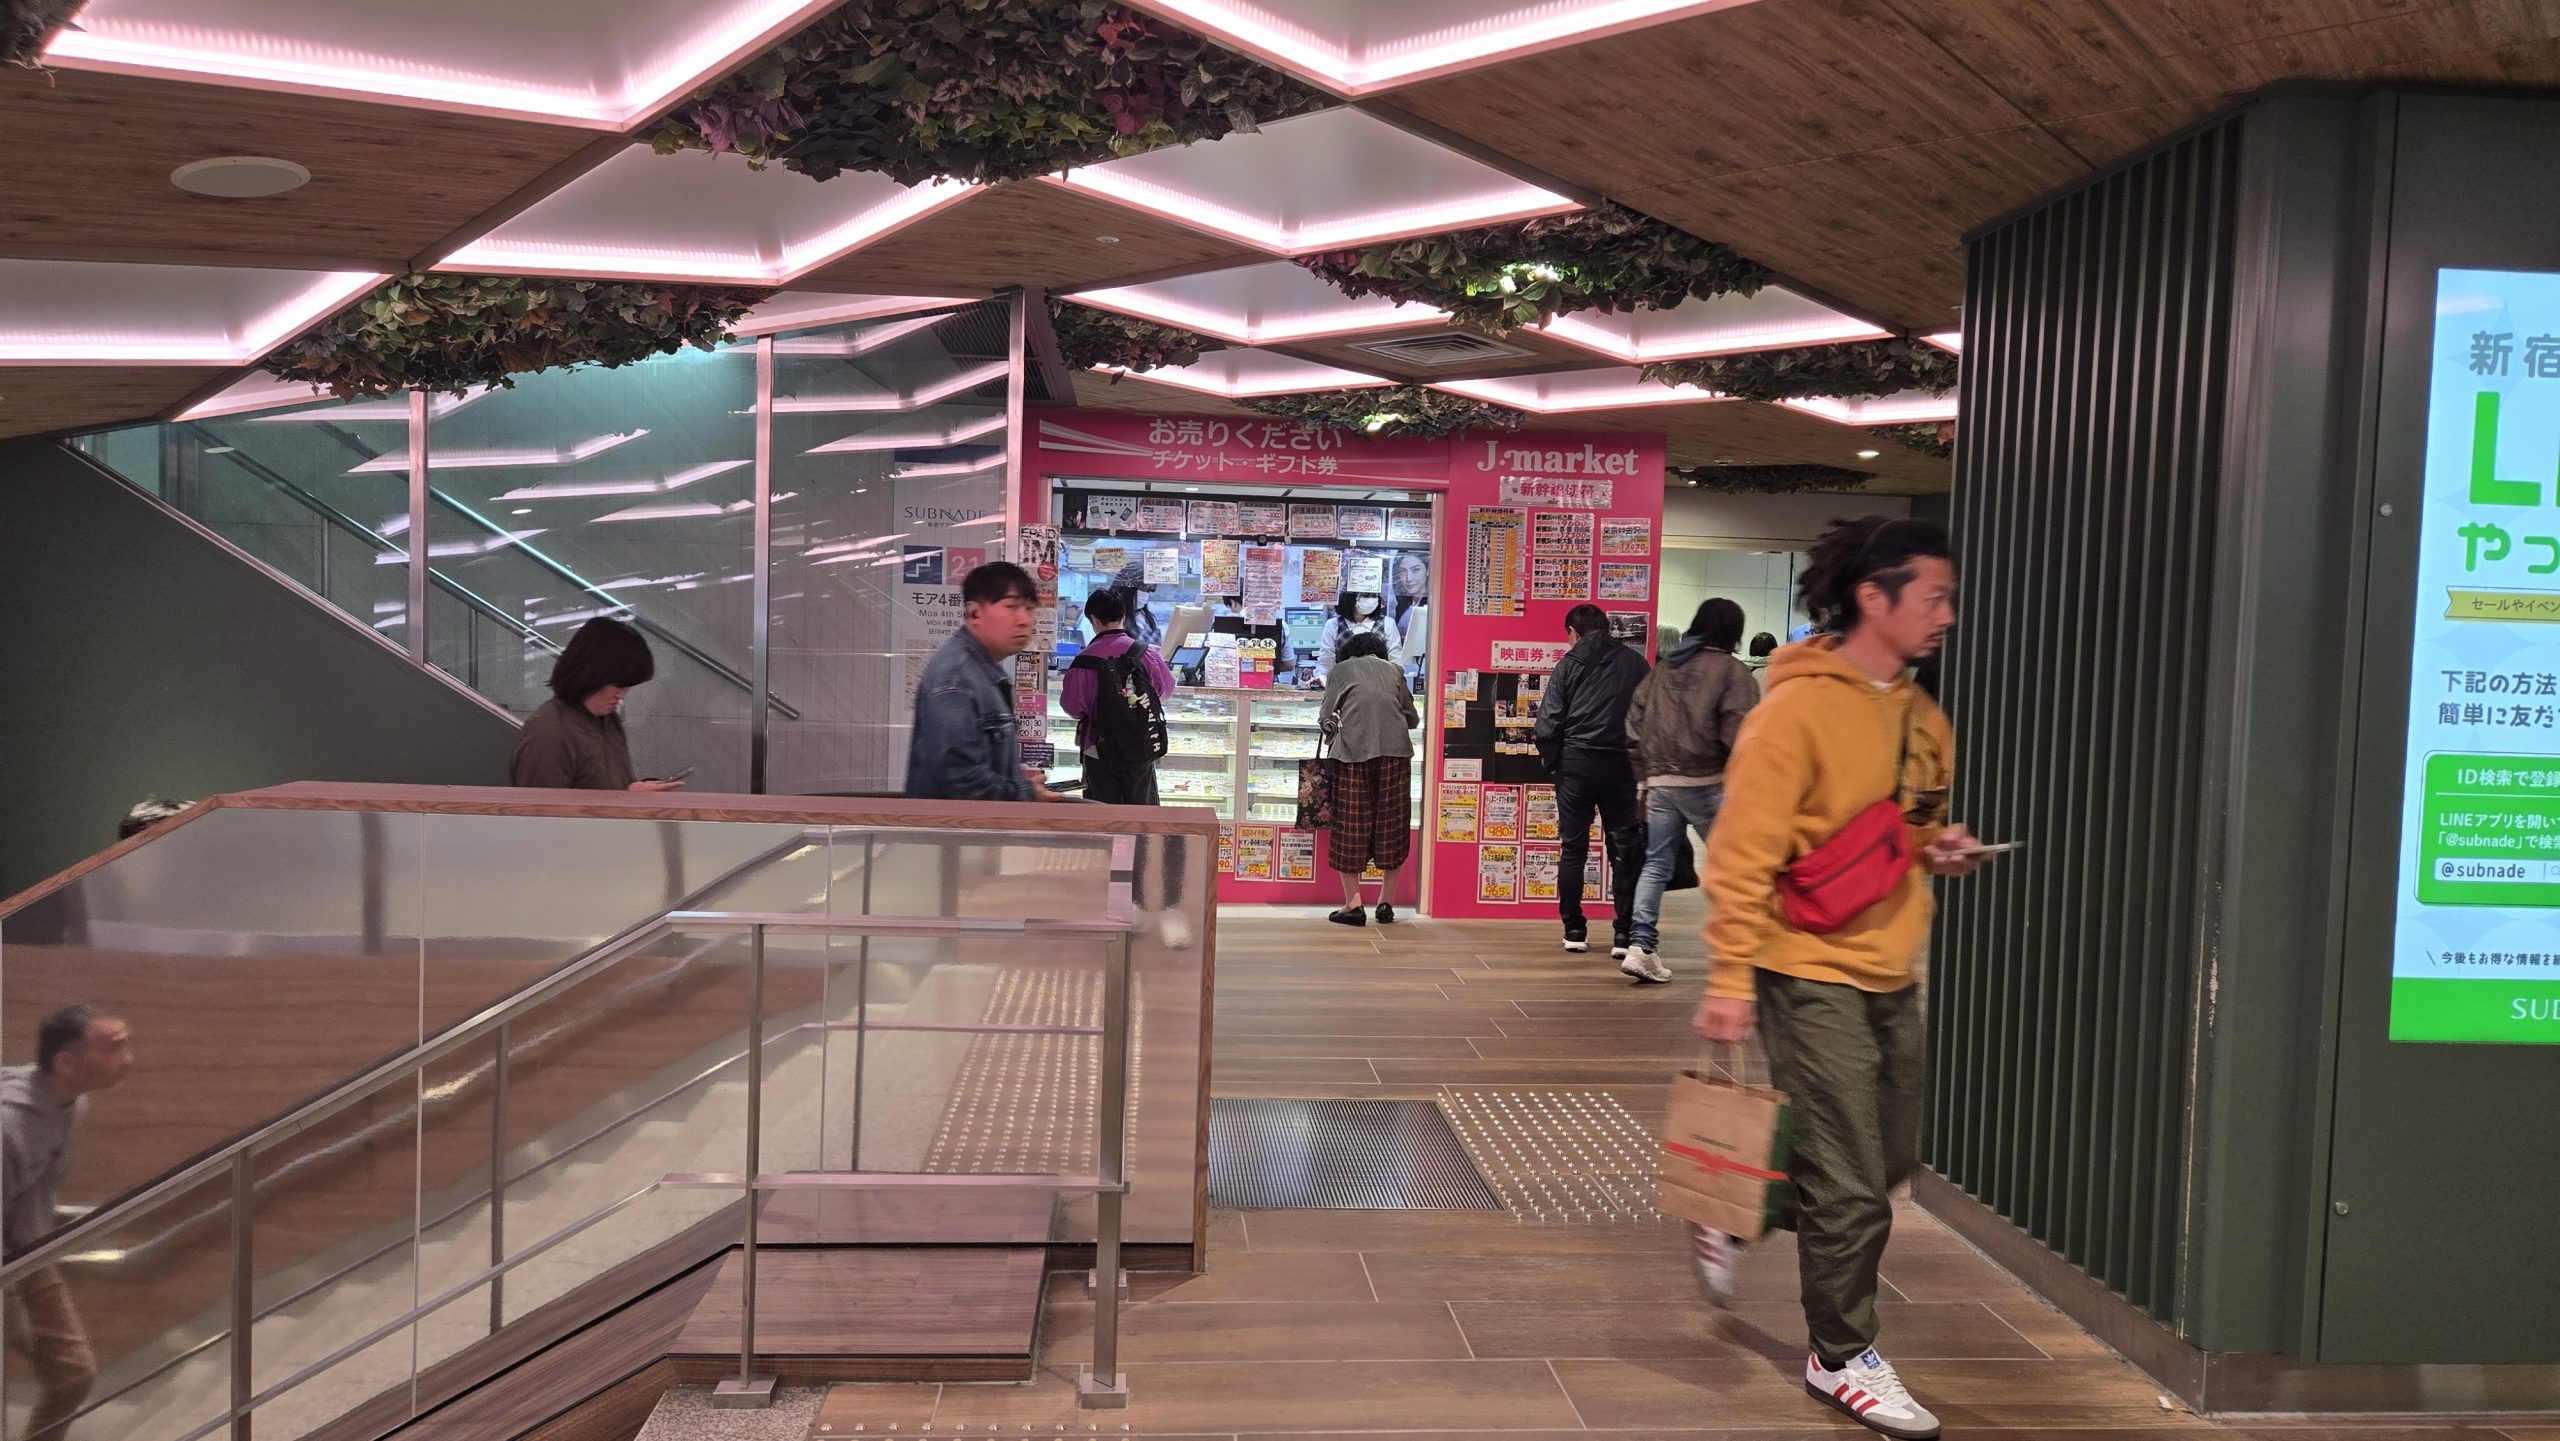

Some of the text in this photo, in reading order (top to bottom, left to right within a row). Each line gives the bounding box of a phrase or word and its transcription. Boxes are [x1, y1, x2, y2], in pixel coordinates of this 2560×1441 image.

[1148, 419, 1342, 451] お売りください
[1152, 450, 1338, 475] チケット・ギフト券
[2441, 670, 2557, 696] 下記の方法
[2439, 702, 2560, 728] 簡単に友だ
[2441, 862, 2526, 879] @subnade
